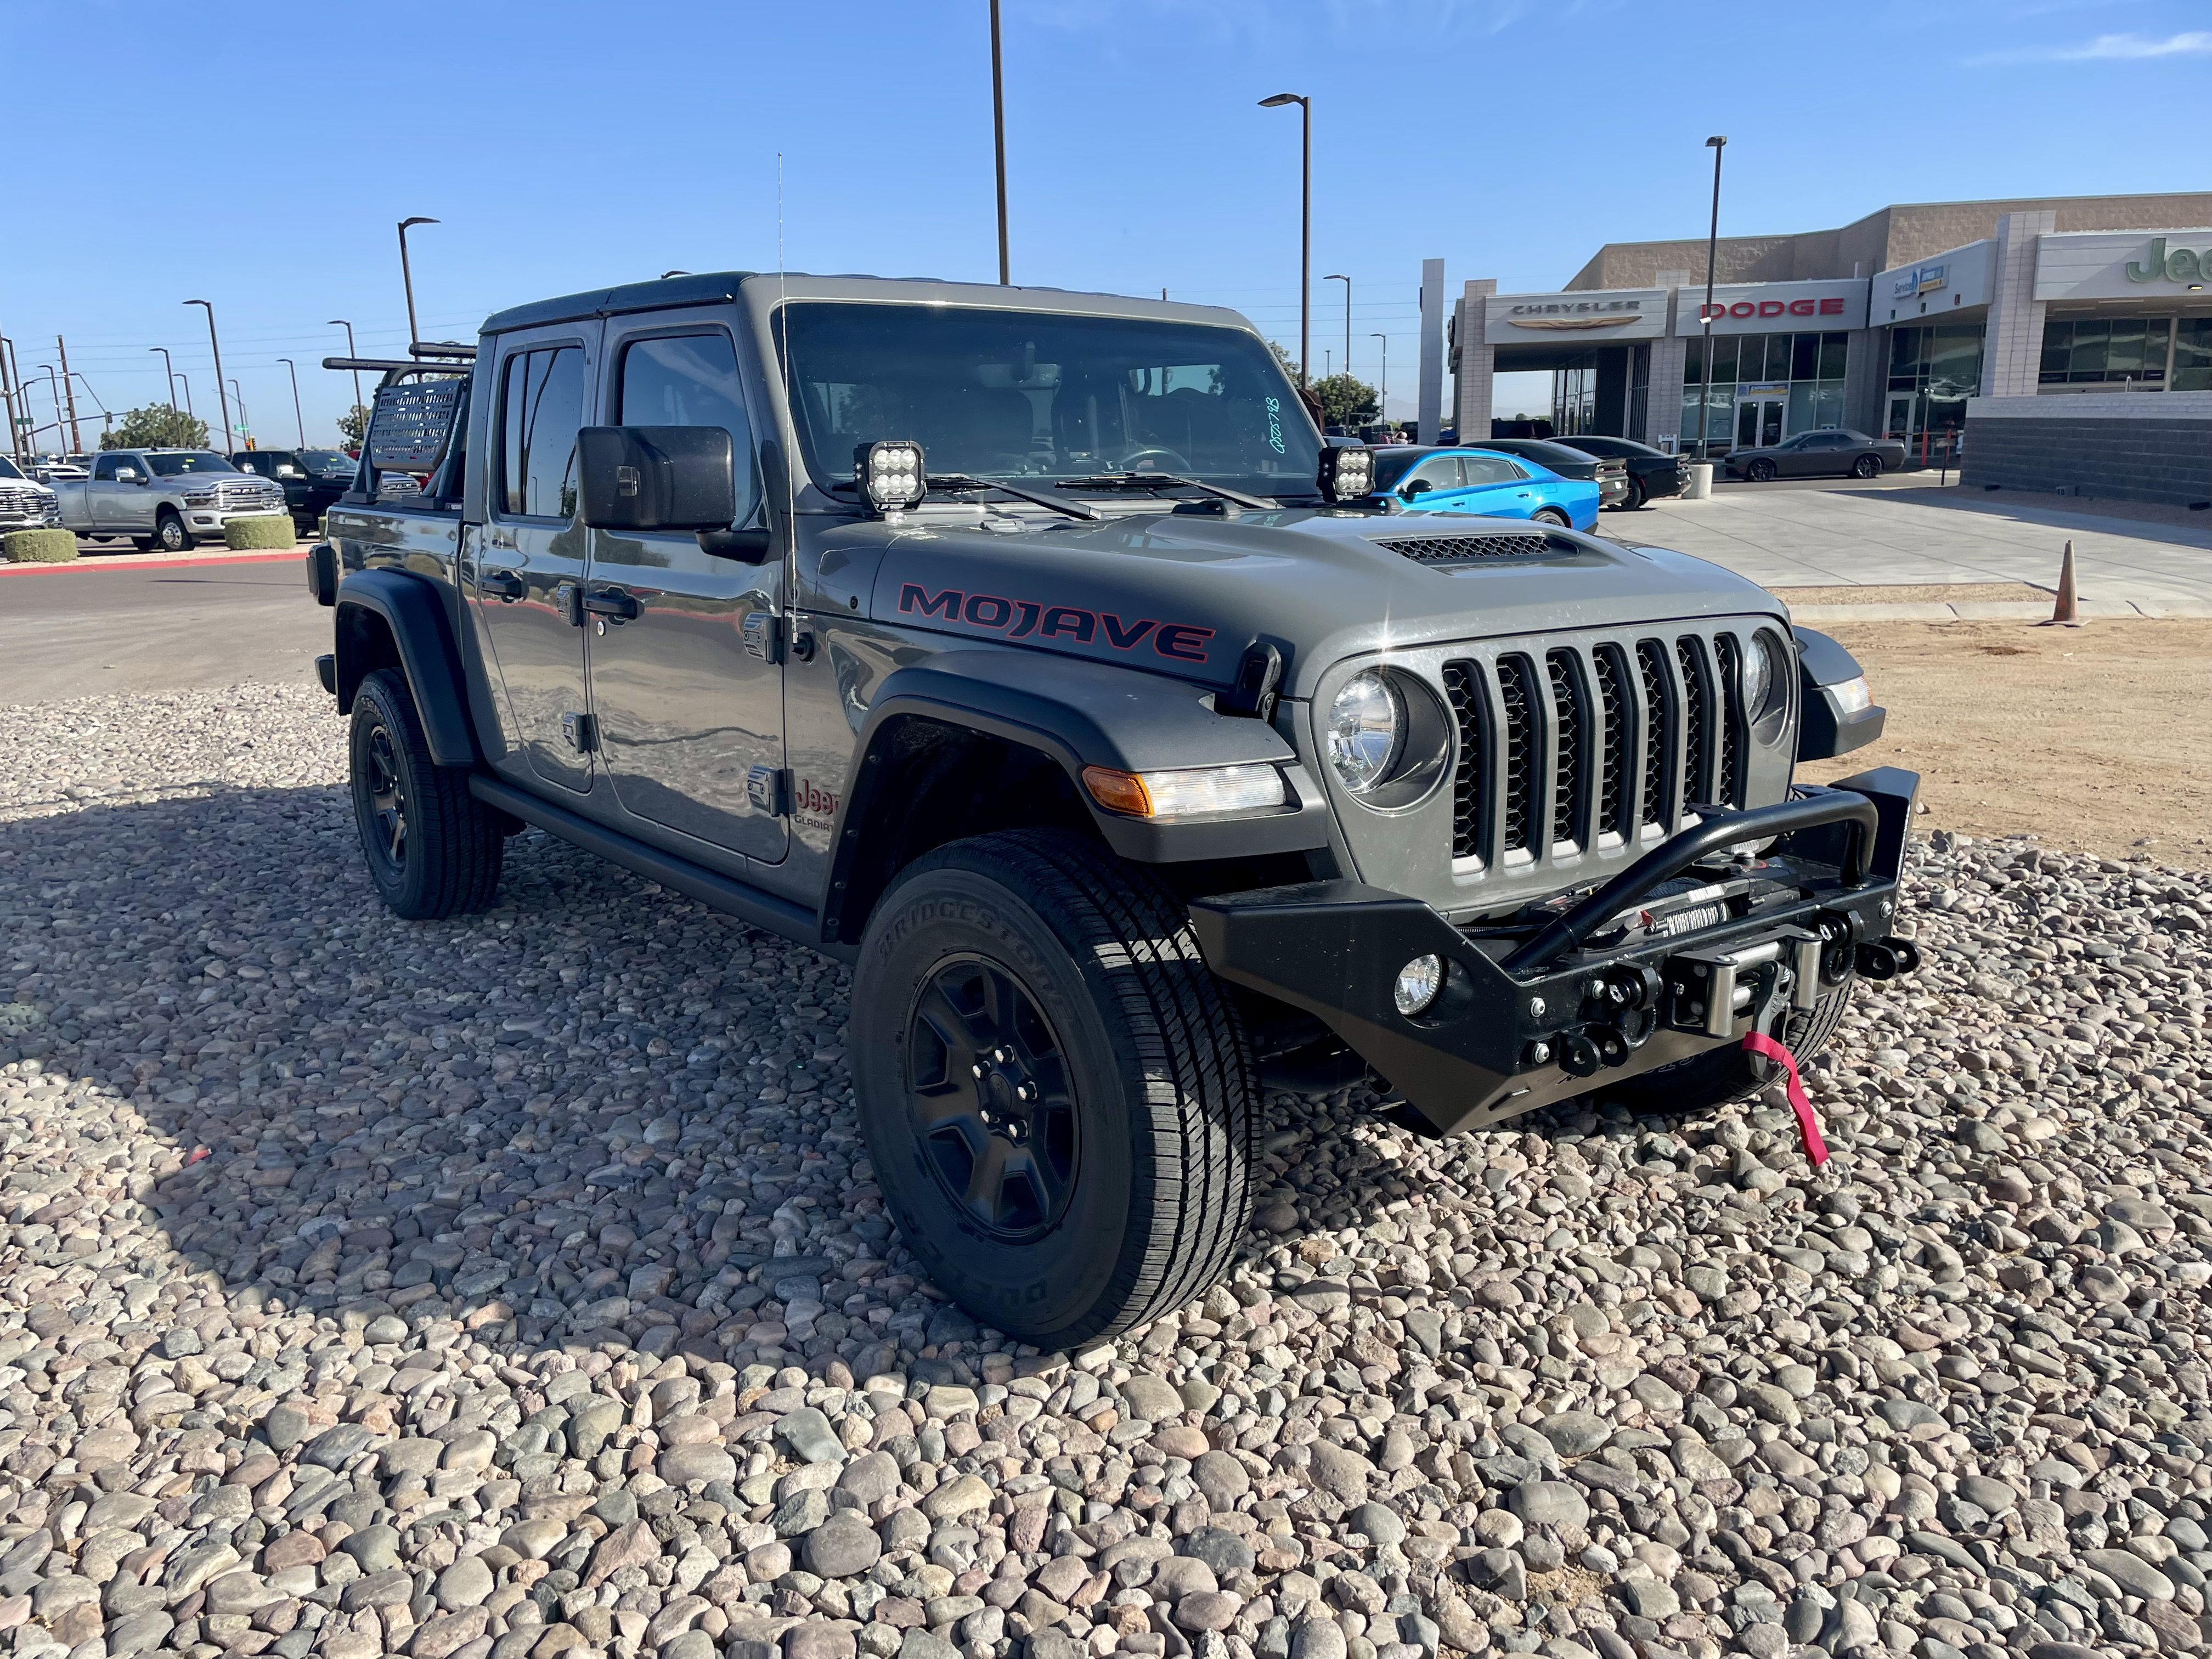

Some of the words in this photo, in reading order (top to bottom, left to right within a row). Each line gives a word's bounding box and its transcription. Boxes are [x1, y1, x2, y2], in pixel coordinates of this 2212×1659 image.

[1513, 301, 1640, 315] CHRYSLER
[1700, 298, 1844, 319] DODGE
[898, 582, 1216, 663] MOJAVE
[874, 897, 1073, 1023] BRIDGESTONE
